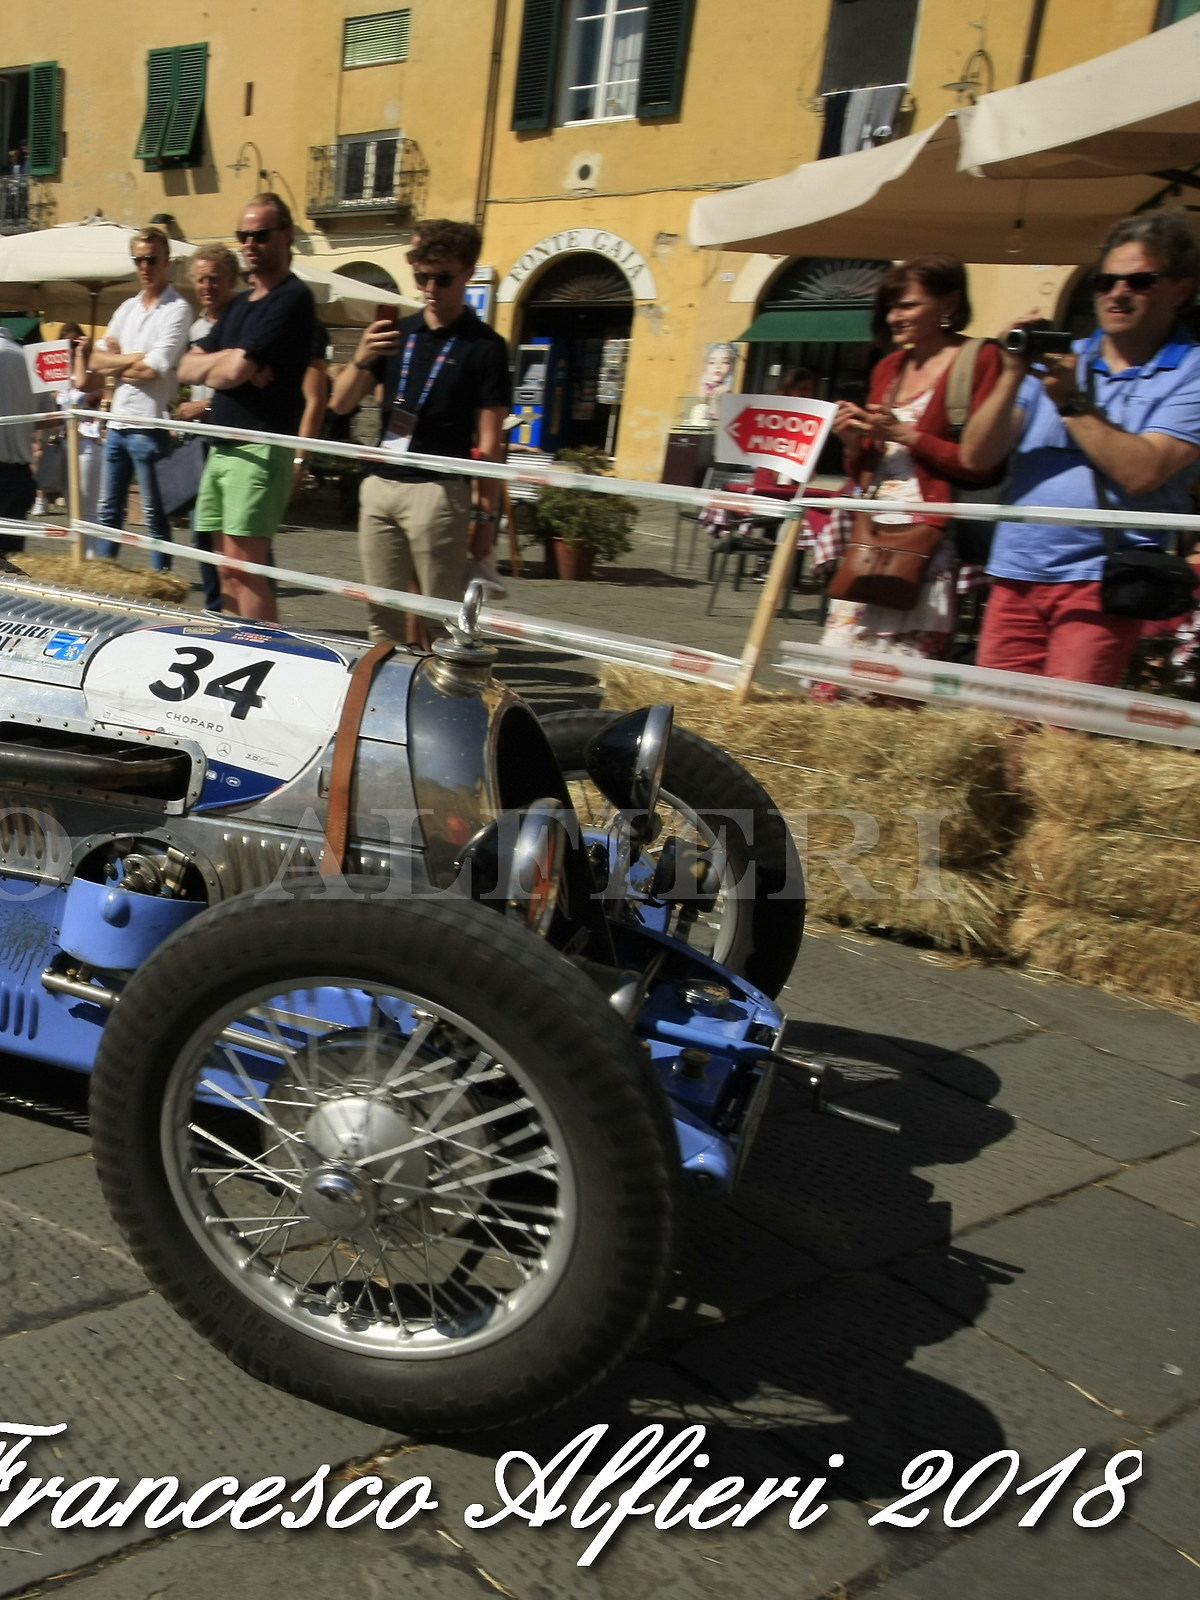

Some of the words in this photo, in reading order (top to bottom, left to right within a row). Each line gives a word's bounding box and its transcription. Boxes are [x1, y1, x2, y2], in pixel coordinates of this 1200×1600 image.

[509, 229, 582, 283] FONTE
[592, 231, 648, 280] GAIA
[753, 413, 820, 437] 1000
[148, 646, 276, 720] 34
[165, 711, 224, 733] CHOPARD
